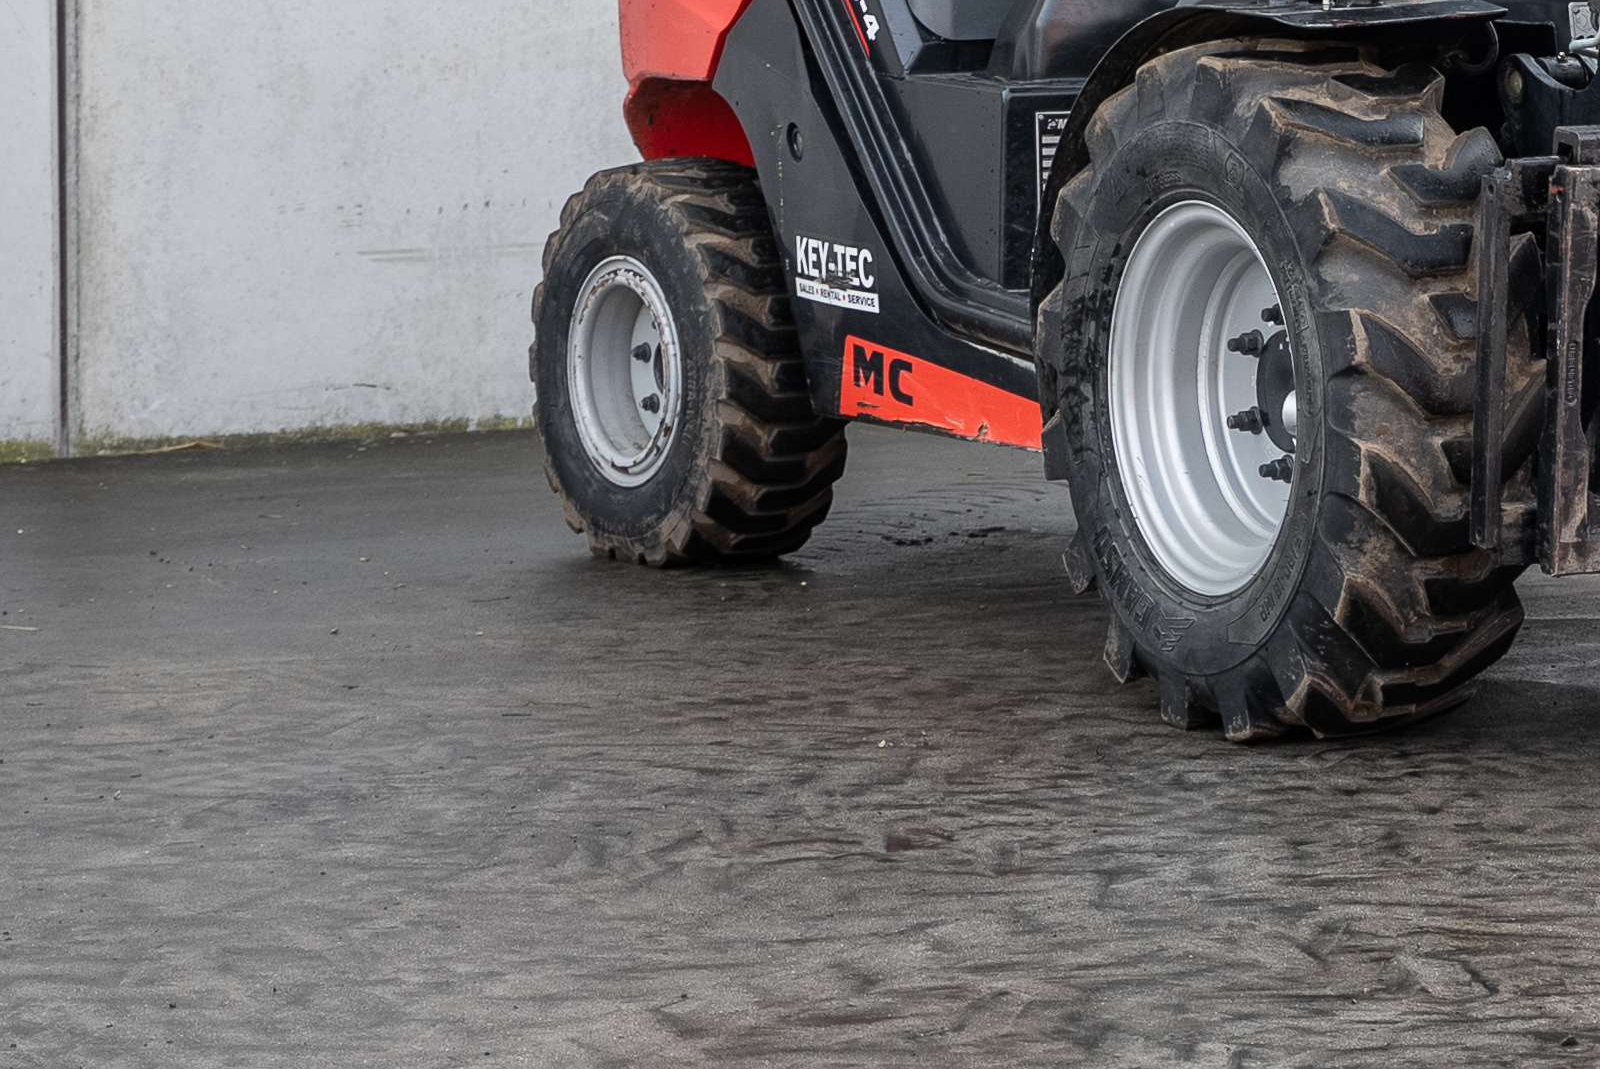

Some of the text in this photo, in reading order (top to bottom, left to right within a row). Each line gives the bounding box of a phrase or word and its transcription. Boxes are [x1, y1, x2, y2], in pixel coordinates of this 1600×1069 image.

[795, 235, 875, 289] KEY-TEC
[799, 282, 876, 308] SALES RENTAL SERVICE
[852, 344, 914, 407] MC
[1092, 523, 1155, 632] CAMSO
